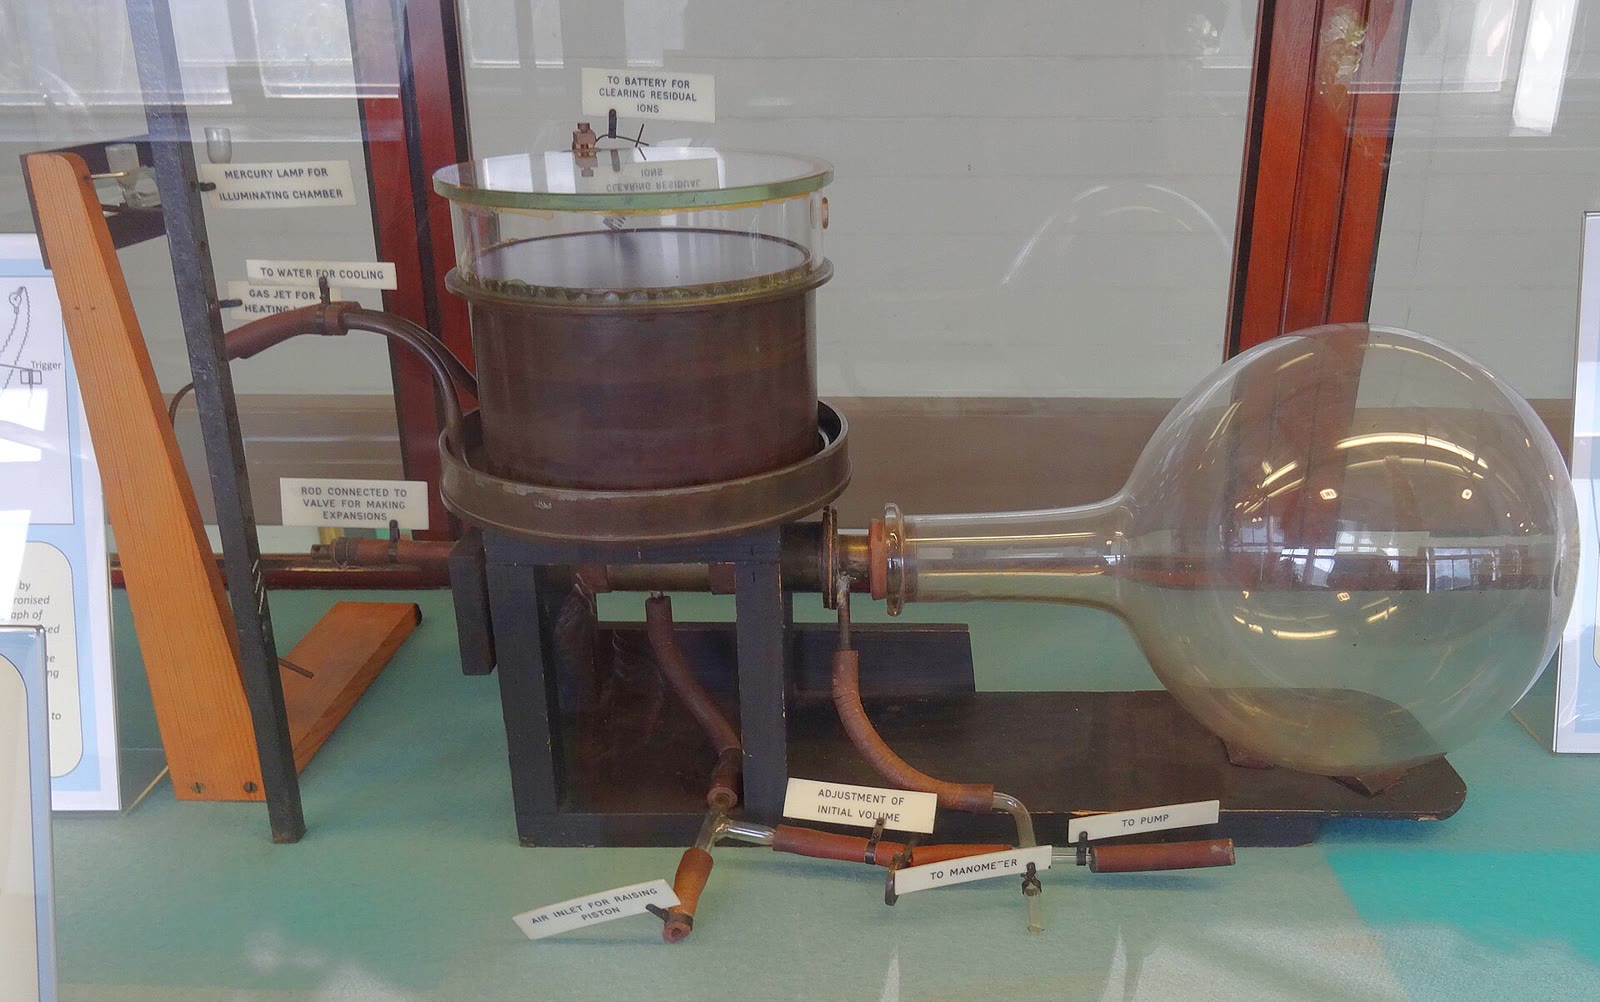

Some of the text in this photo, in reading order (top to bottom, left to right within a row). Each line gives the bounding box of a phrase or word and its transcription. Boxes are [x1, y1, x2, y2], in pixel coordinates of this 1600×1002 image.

[608, 76, 690, 89] TO BATTERY FOR
[599, 88, 697, 102] CLEARING RESIDUAL
[637, 104, 659, 113] IONS
[224, 167, 328, 180] MERCURY LAMP FOR
[219, 189, 343, 201] ILLUMINATING CHAMBER
[260, 267, 384, 280] TO WATER FOR COOLING
[249, 289, 316, 300] GAS JET FOR
[31, 361, 62, 371] Trigger
[301, 486, 407, 497] ROD CONNECTED TO
[303, 499, 406, 510] VALVE FOR MAKING
[323, 511, 387, 521] EXPANSIONS
[19, 580, 31, 592] by
[32, 609, 43, 621] of
[51, 712, 62, 721] to
[818, 788, 905, 806] ADJUSTMENT OF
[817, 805, 900, 823] INITIAL VOLUME
[1122, 814, 1169, 827] TO PUMP
[930, 870, 944, 880] TO
[531, 888, 658, 925] AIR INLET FOR RAISING
[581, 906, 621, 921] PISTON
